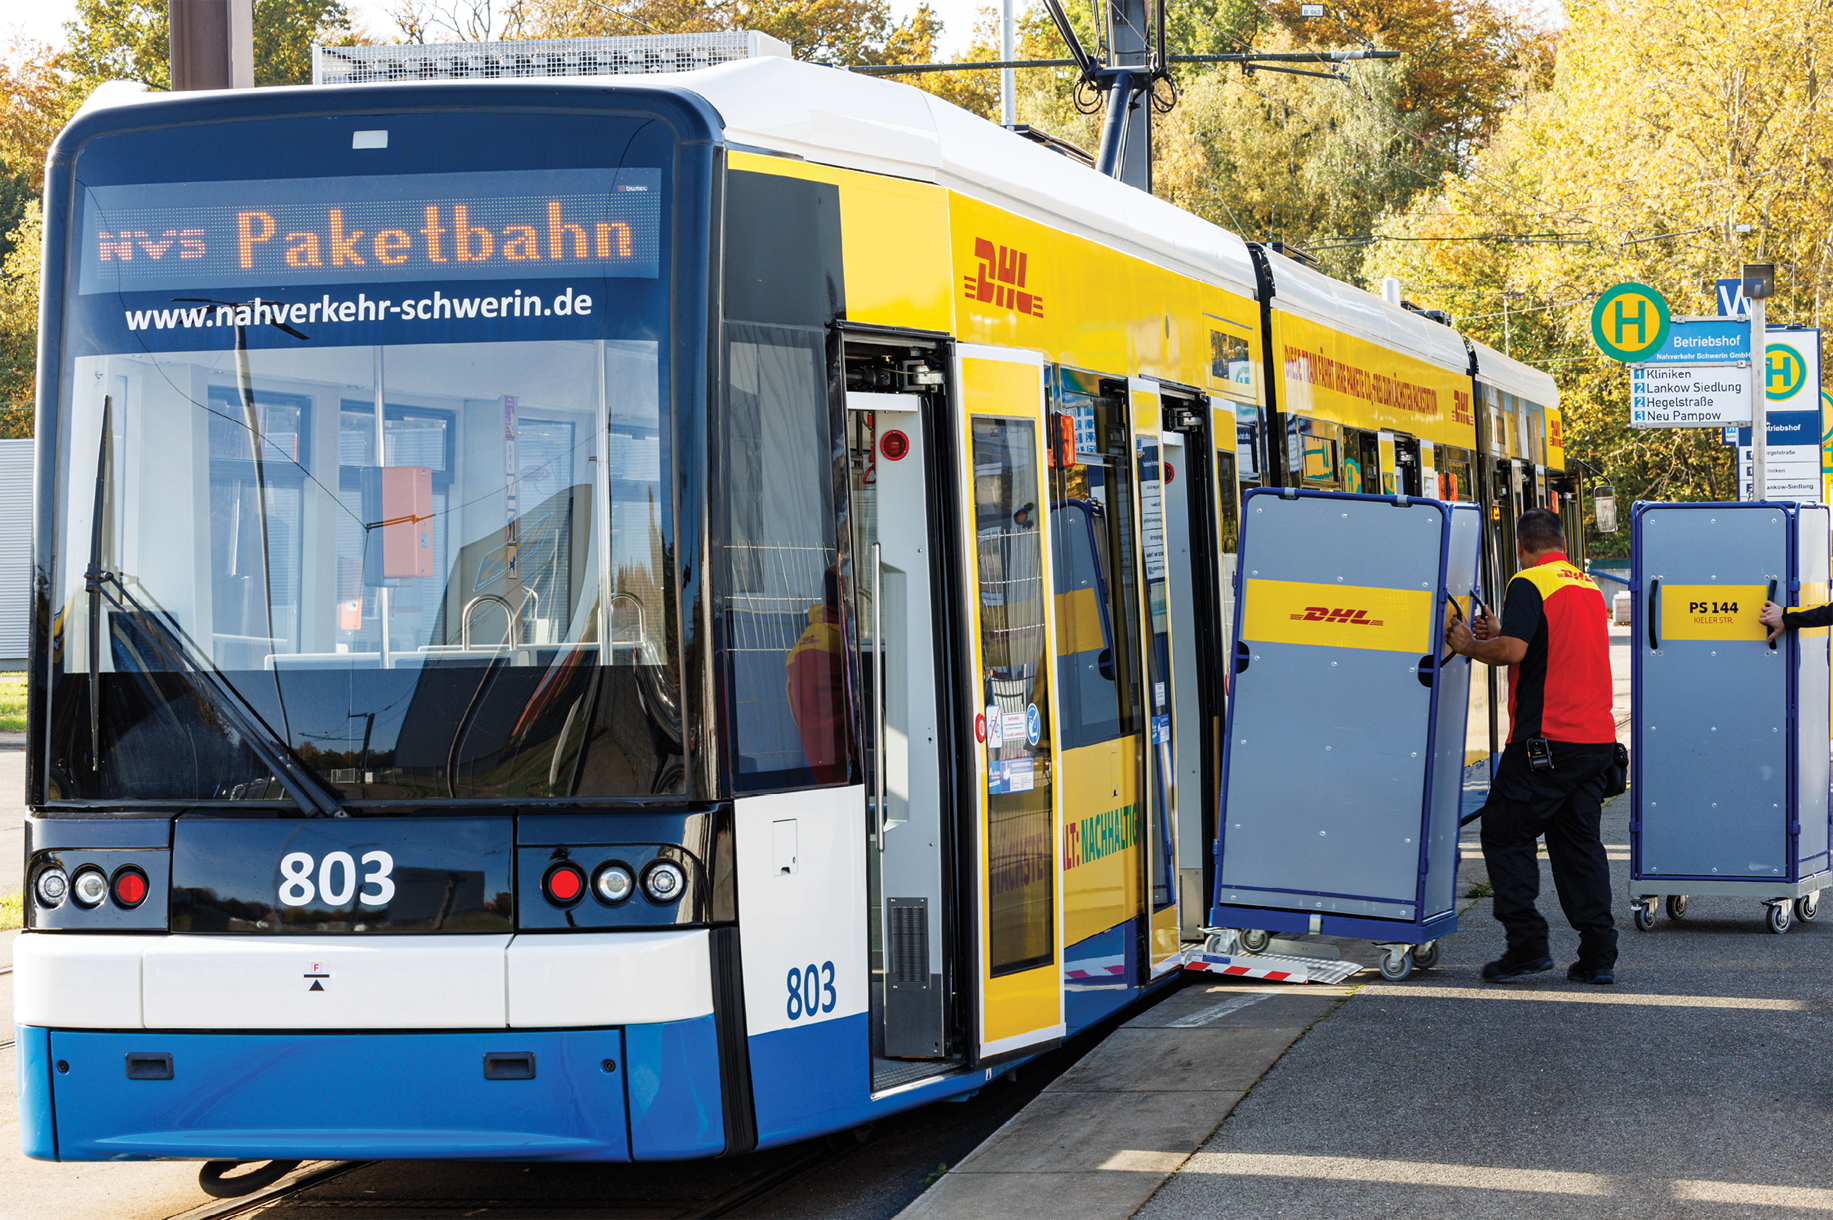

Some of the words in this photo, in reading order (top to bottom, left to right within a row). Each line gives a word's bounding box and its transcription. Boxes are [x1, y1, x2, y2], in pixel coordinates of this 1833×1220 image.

[99, 229, 205, 261] NVS
[238, 202, 632, 269] Paketbahn
[974, 237, 1034, 316] DHL
[125, 287, 593, 330] www.nahverkehr-schwerin.de
[1615, 301, 1646, 344] H
[1673, 335, 1741, 348] Betriebshof
[1697, 352, 1728, 360] Schwerin
[1730, 351, 1750, 359] GmbH
[1646, 369, 1692, 379] Kliniken
[1637, 383, 1643, 393] 2
[1647, 383, 1690, 393] Lankow
[1693, 382, 1742, 394] Siedlung
[1637, 398, 1643, 408] 2
[1647, 396, 1714, 410] Hegelstraße
[1637, 411, 1643, 420] 3
[1647, 411, 1669, 421] Neu
[1673, 411, 1721, 422] Pampow
[1689, 602, 1708, 613] PS
[1712, 602, 1738, 613] 144
[1302, 607, 1372, 626] DHL
[278, 850, 397, 906] 803
[313, 963, 320, 972] F
[786, 960, 837, 1021] 803
